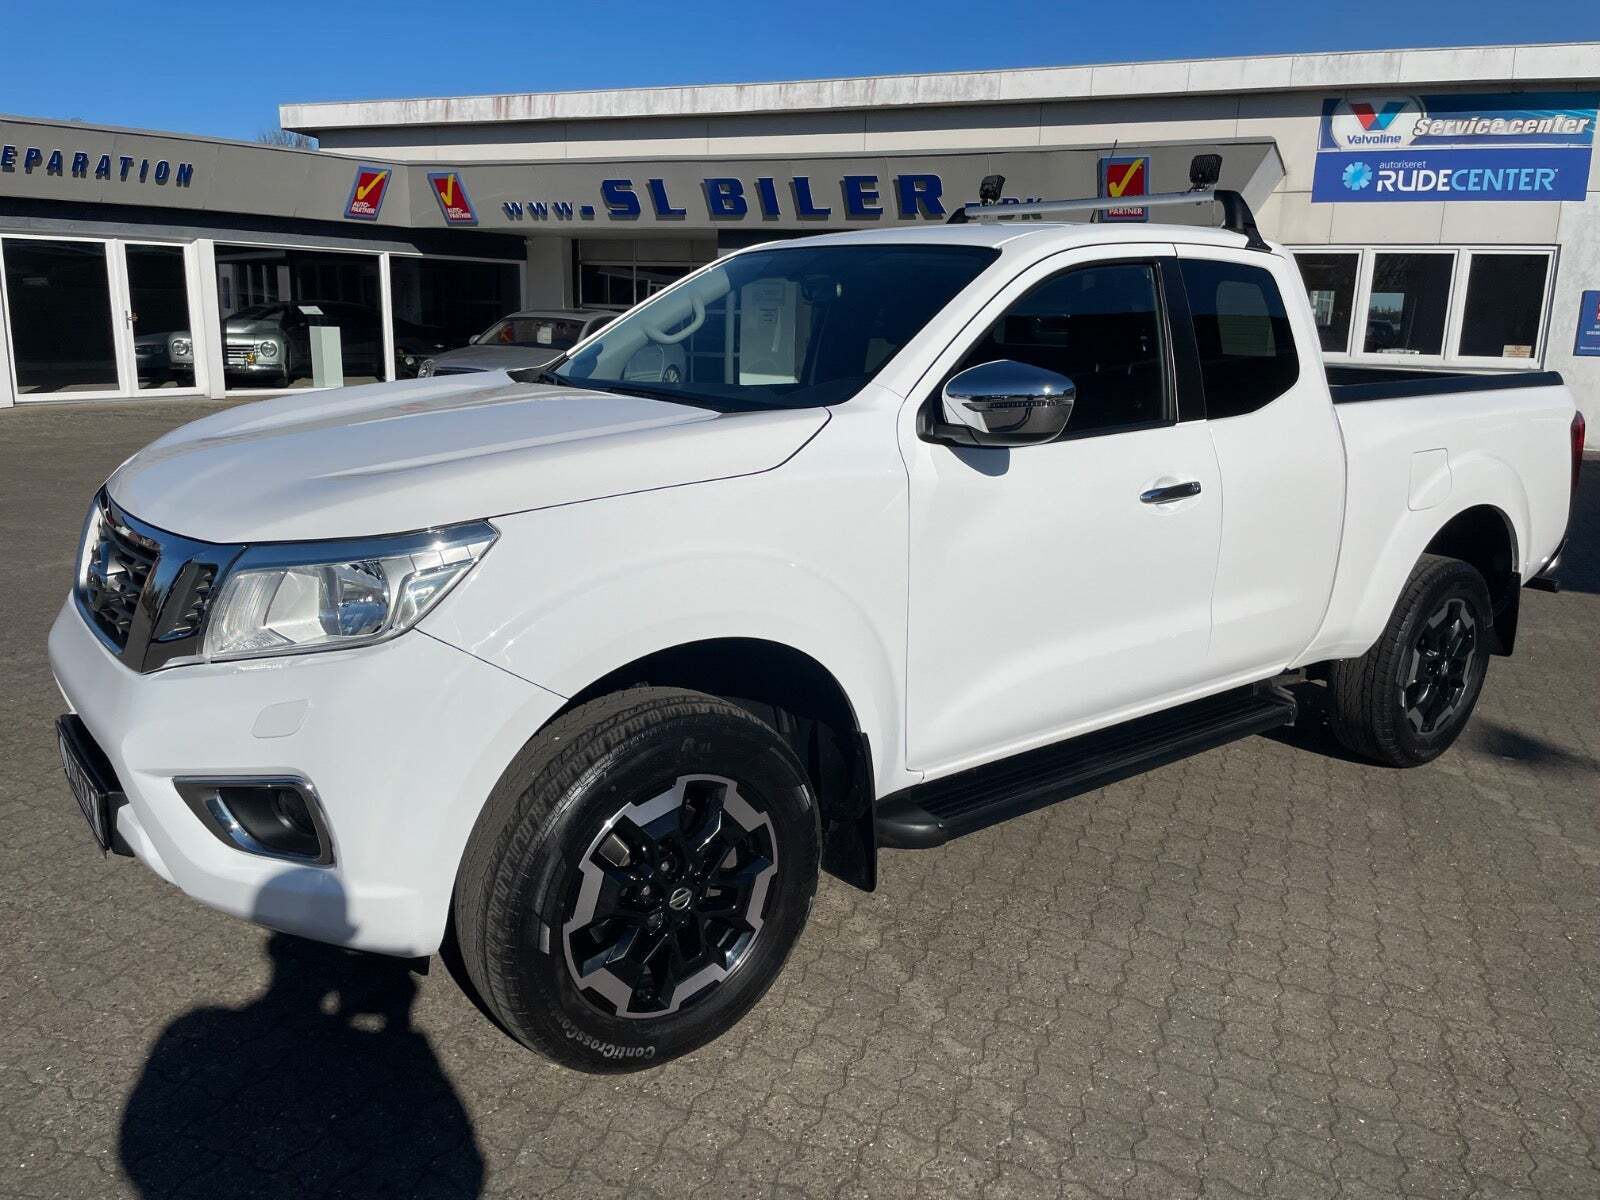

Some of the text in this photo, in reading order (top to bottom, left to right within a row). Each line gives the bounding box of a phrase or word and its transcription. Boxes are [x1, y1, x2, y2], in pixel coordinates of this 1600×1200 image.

[1413, 115, 1590, 136] Service center
[1347, 134, 1402, 145] Valvoline
[1379, 160, 1427, 169] autoriseret
[1376, 168, 1557, 192] RUDECENTER
[702, 174, 947, 218] BILER
[1108, 207, 1143, 215] PARTNER
